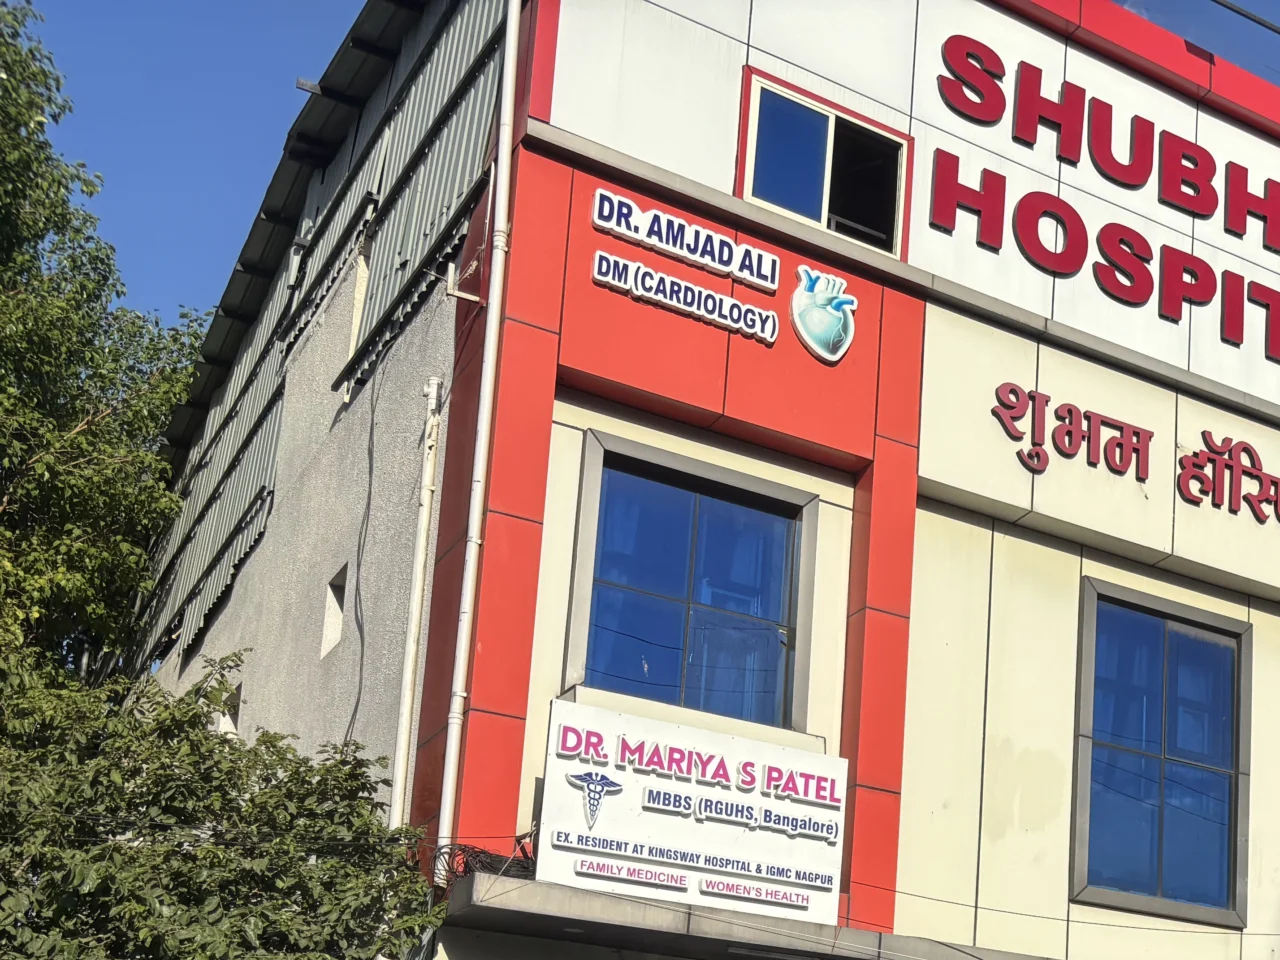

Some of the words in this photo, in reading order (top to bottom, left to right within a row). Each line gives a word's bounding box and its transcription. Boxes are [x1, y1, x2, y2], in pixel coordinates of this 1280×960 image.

[597, 193, 640, 234] DR.
[646, 213, 734, 268] AMJAD
[742, 248, 777, 285] ALI
[596, 256, 629, 286] DM
[634, 266, 778, 340] (CARDIOLOGY)
[991, 381, 1154, 482] शुभम
[560, 725, 609, 761] DR.
[619, 735, 731, 784] MARIYA
[740, 761, 756, 787] S
[766, 765, 842, 804] PATEL
[647, 788, 693, 811] MBBS
[698, 797, 758, 824] (RGUHS,
[763, 809, 840, 838] Bangalore)
[556, 831, 573, 845] EX.
[576, 834, 629, 854] RESIDENT
[632, 843, 645, 856] AT
[648, 845, 701, 865] KINGSWAY
[704, 855, 753, 873] HOSPITAL
[755, 863, 763, 875] &
[766, 865, 792, 880] IGMC
[795, 870, 834, 886] NAGPUR
[580, 859, 624, 876] FAMILY
[626, 867, 687, 886] MEDICINE
[765, 888, 810, 906] HEALTH
